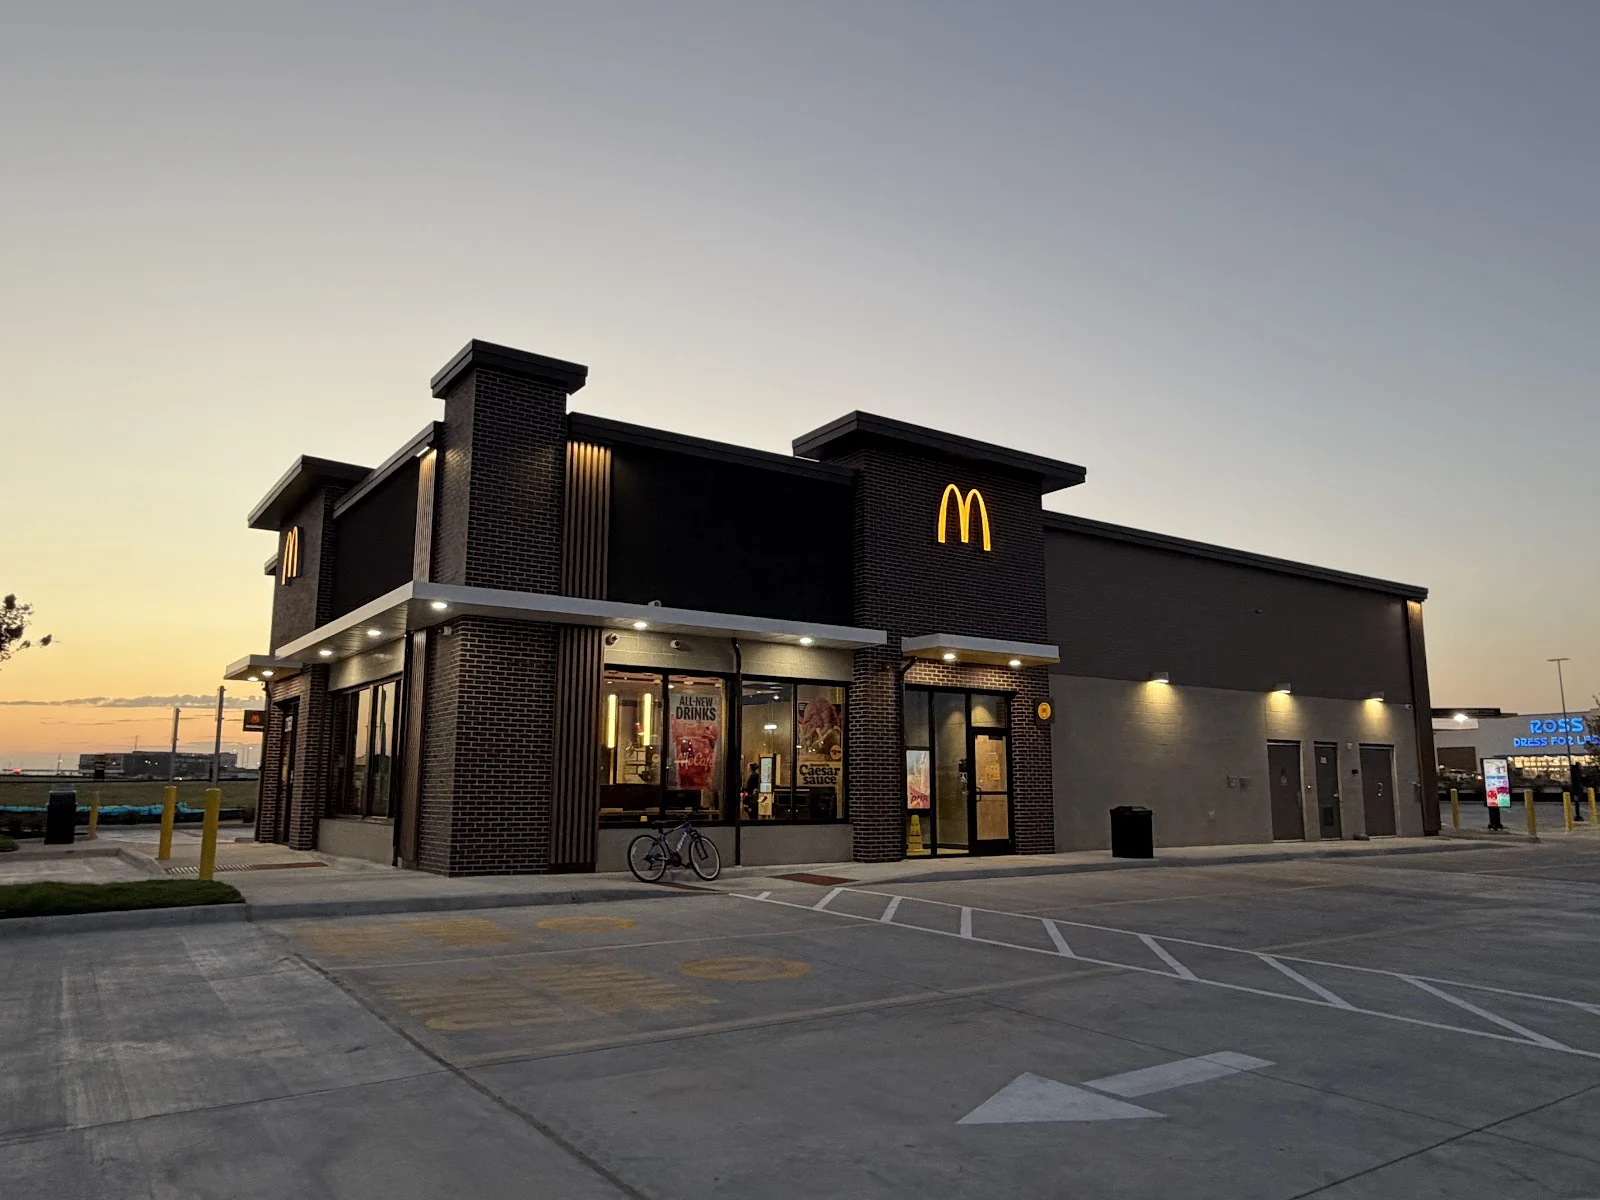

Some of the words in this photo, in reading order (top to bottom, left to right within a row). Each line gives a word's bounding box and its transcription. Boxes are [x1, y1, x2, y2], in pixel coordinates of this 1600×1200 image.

[679, 696, 713, 707] ALL-NEW
[676, 706, 716, 721] DRINKS
[1530, 717, 1584, 734] ROSS
[1514, 737, 1548, 747] DRESS
[1551, 736, 1574, 746] FOR
[799, 764, 840, 776] Caesar
[803, 776, 837, 785] sauce
